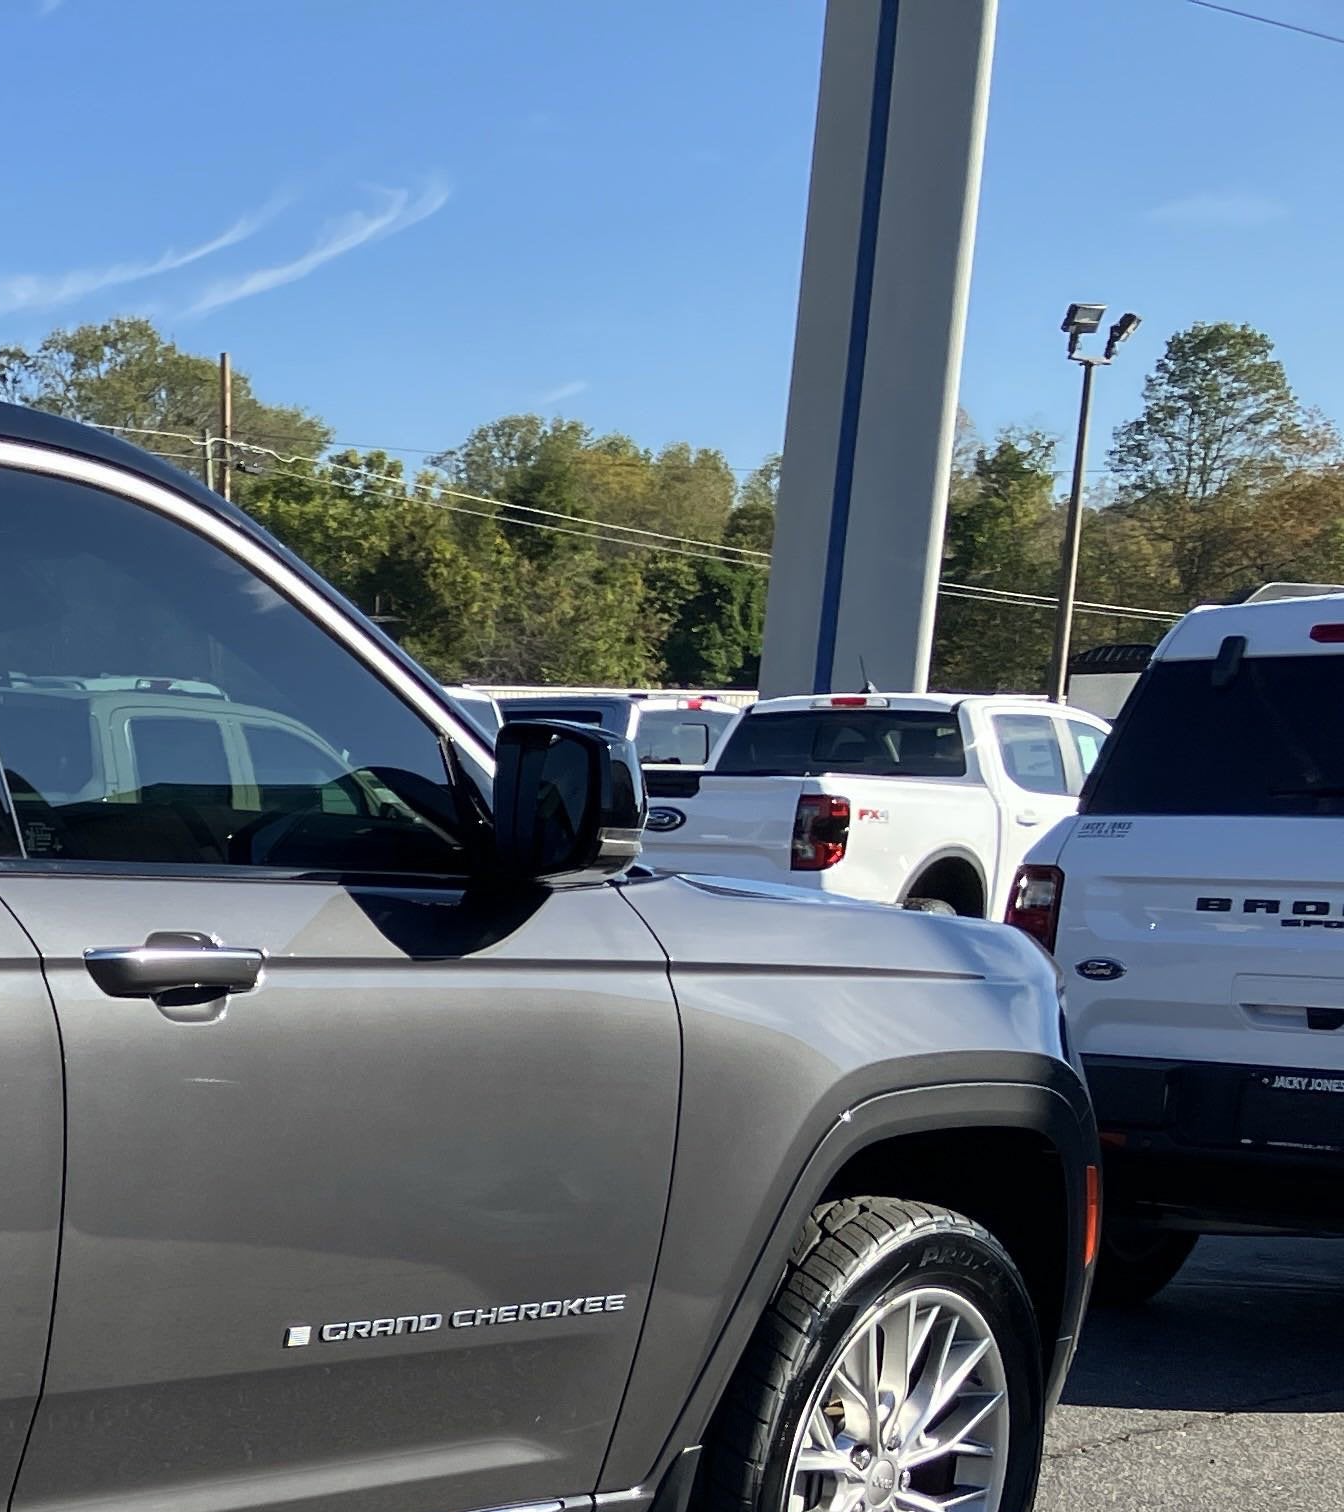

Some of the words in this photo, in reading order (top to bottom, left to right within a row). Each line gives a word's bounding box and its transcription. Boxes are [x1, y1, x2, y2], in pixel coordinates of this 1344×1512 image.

[858, 809, 889, 820] FX4
[1197, 897, 1344, 917] BRO
[1272, 1075, 1308, 1090] JACKY
[320, 1312, 442, 1343] GRAND
[451, 1294, 626, 1329] CHEROKEE
